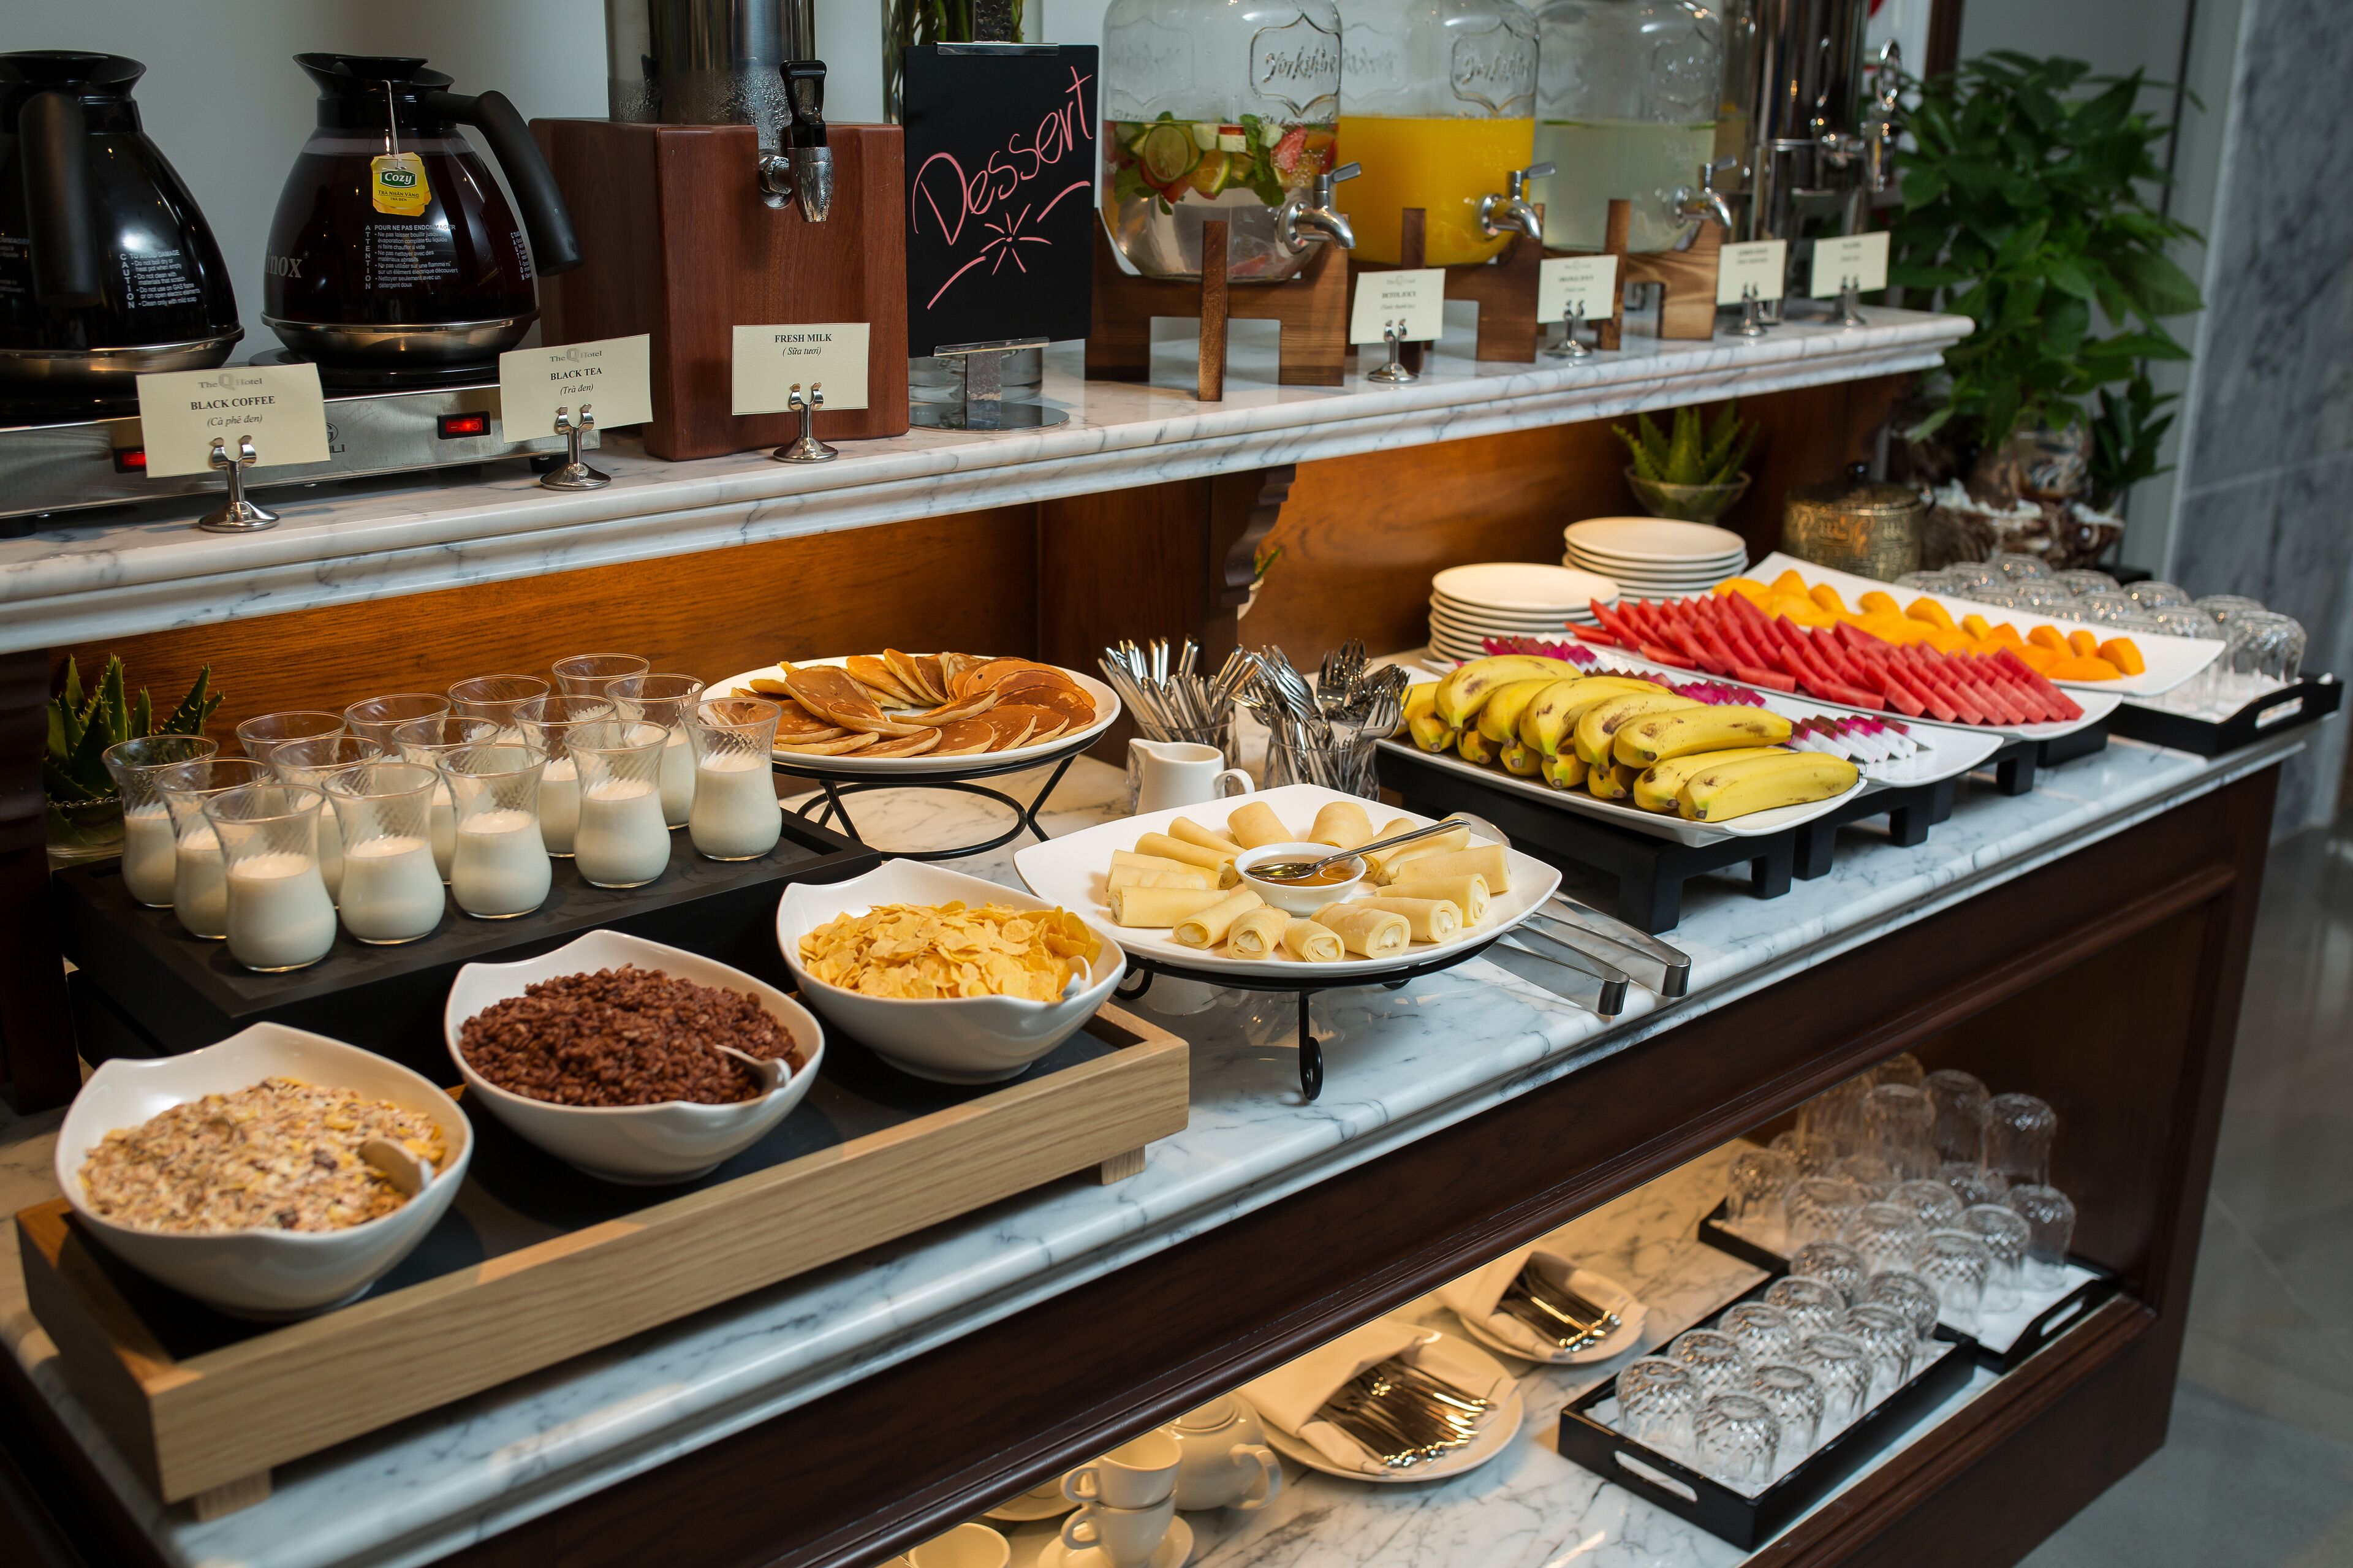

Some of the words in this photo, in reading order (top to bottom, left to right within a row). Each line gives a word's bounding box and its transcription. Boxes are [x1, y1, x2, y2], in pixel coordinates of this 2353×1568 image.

[912, 66, 1093, 246] Dessert
[385, 173, 412, 184] Cozy
[120, 254, 135, 308] CAUTION
[550, 369, 582, 381] BLACK
[561, 385, 576, 396] (Trà
[578, 384, 593, 392] đen)
[191, 399, 229, 410] BLACK
[232, 396, 275, 407] COFFEE
[207, 417, 223, 427] (Cà
[225, 415, 241, 426] phê
[244, 414, 263, 424] đen)
